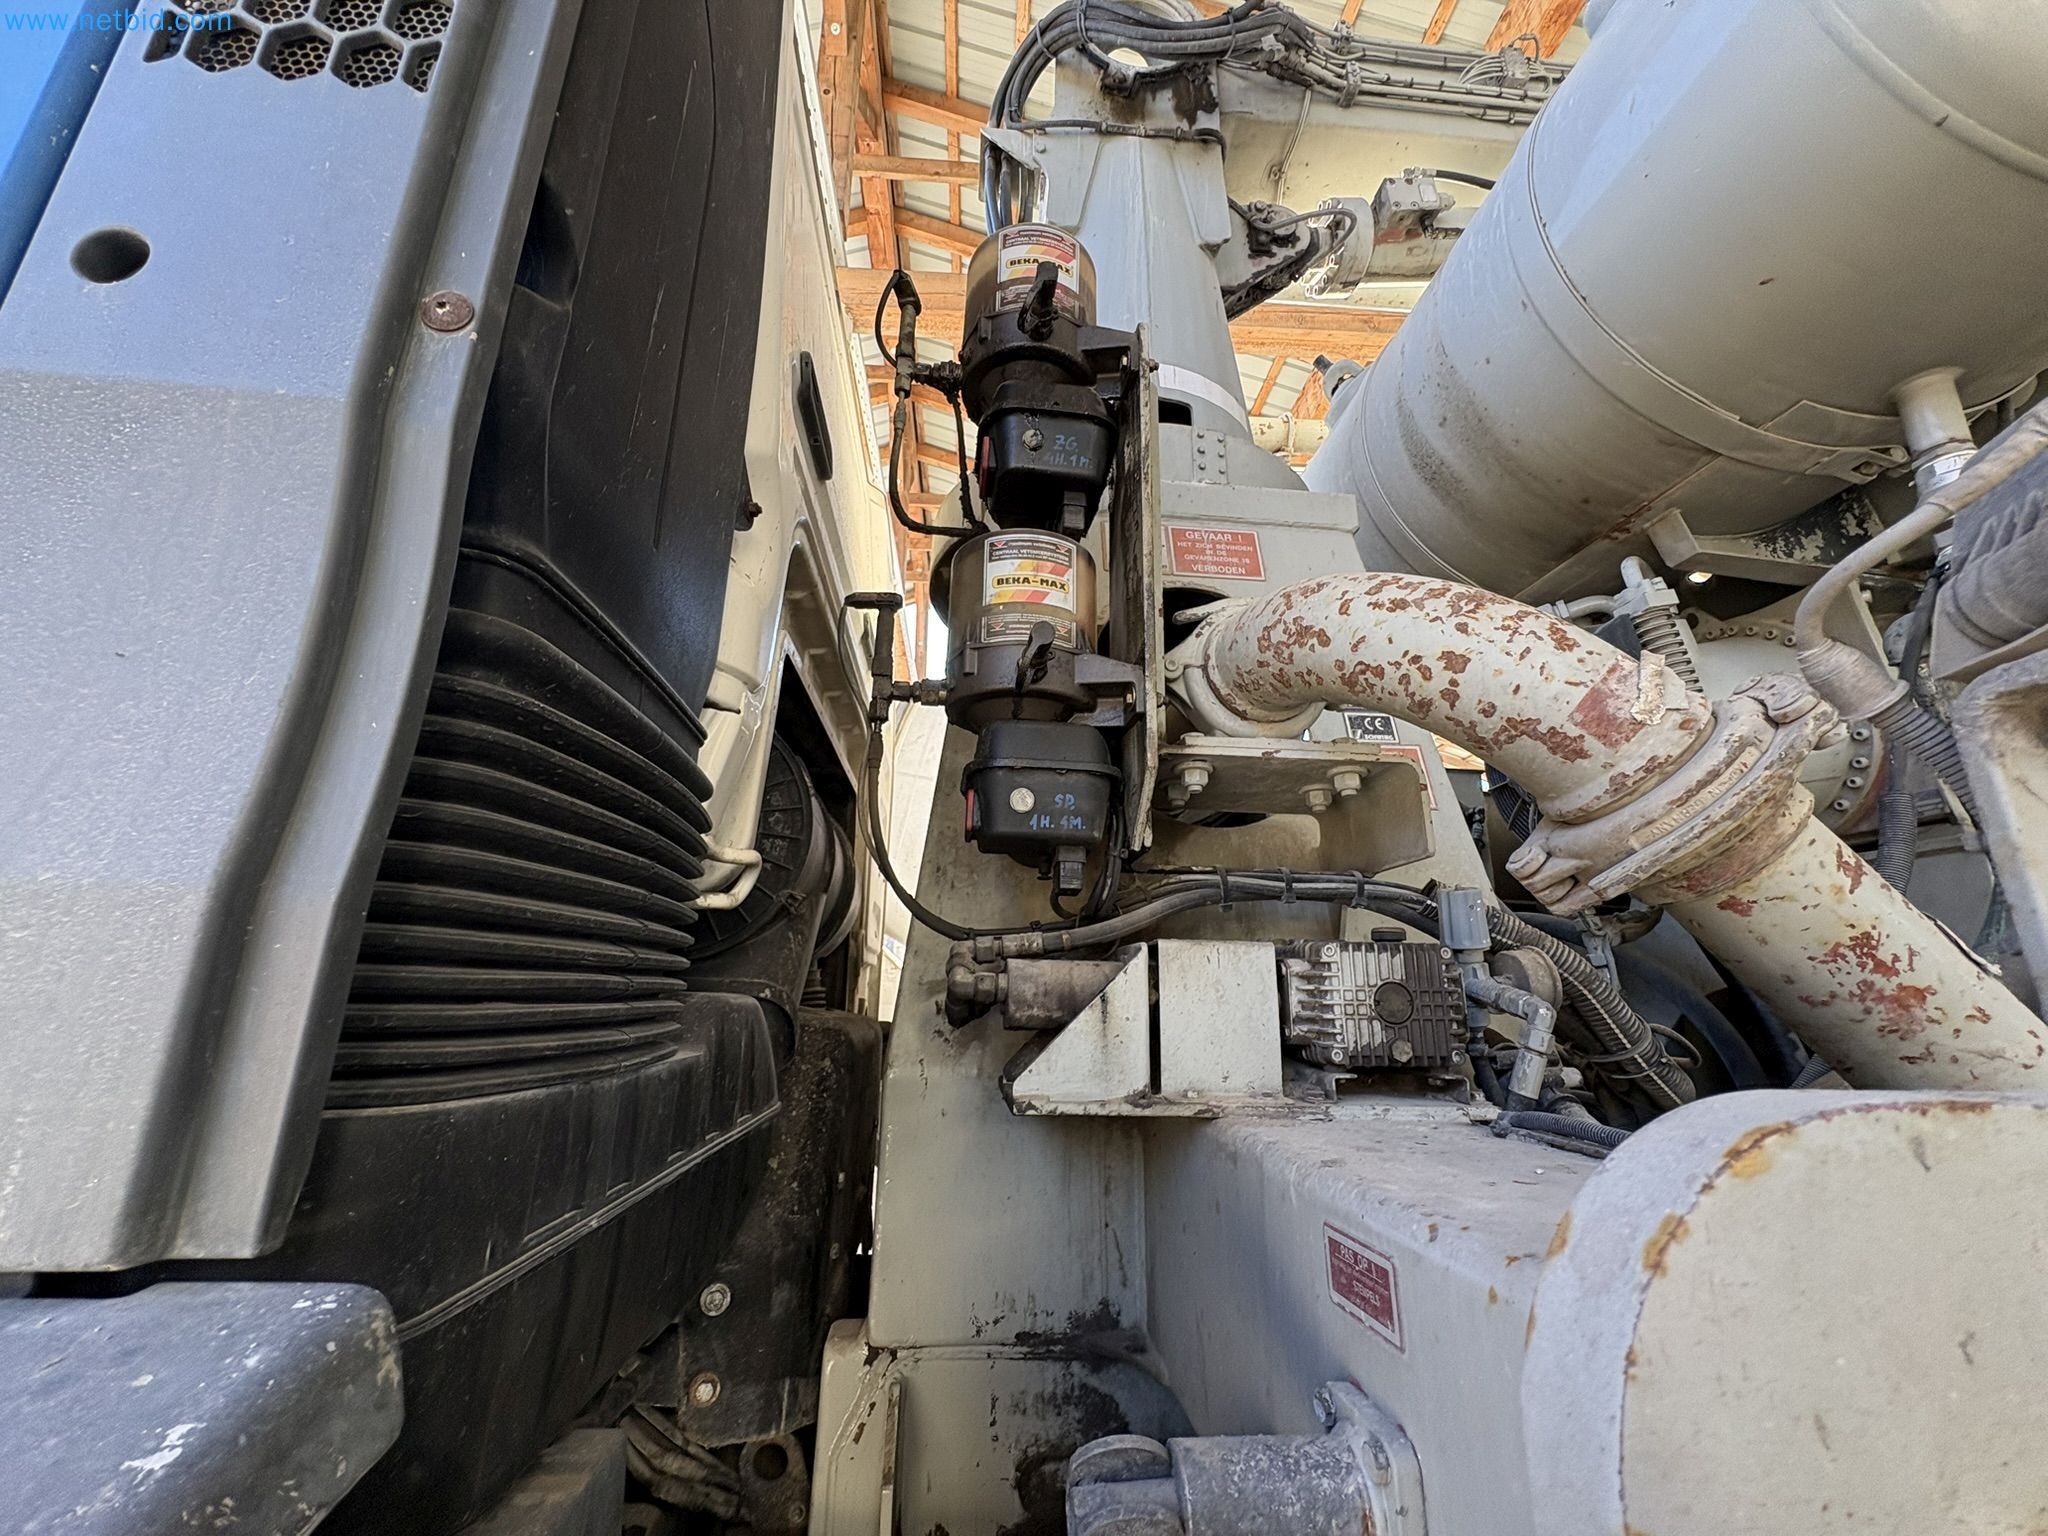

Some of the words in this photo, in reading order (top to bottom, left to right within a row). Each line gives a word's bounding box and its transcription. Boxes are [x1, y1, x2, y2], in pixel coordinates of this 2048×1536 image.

[1009, 258, 1072, 275] BEKAAX
[1185, 531, 1232, 542] GEVAAR
[1191, 564, 1246, 575] VERBODEN
[996, 576, 1067, 592] BEKA-MAX
[1339, 1244, 1355, 1263] PAS
